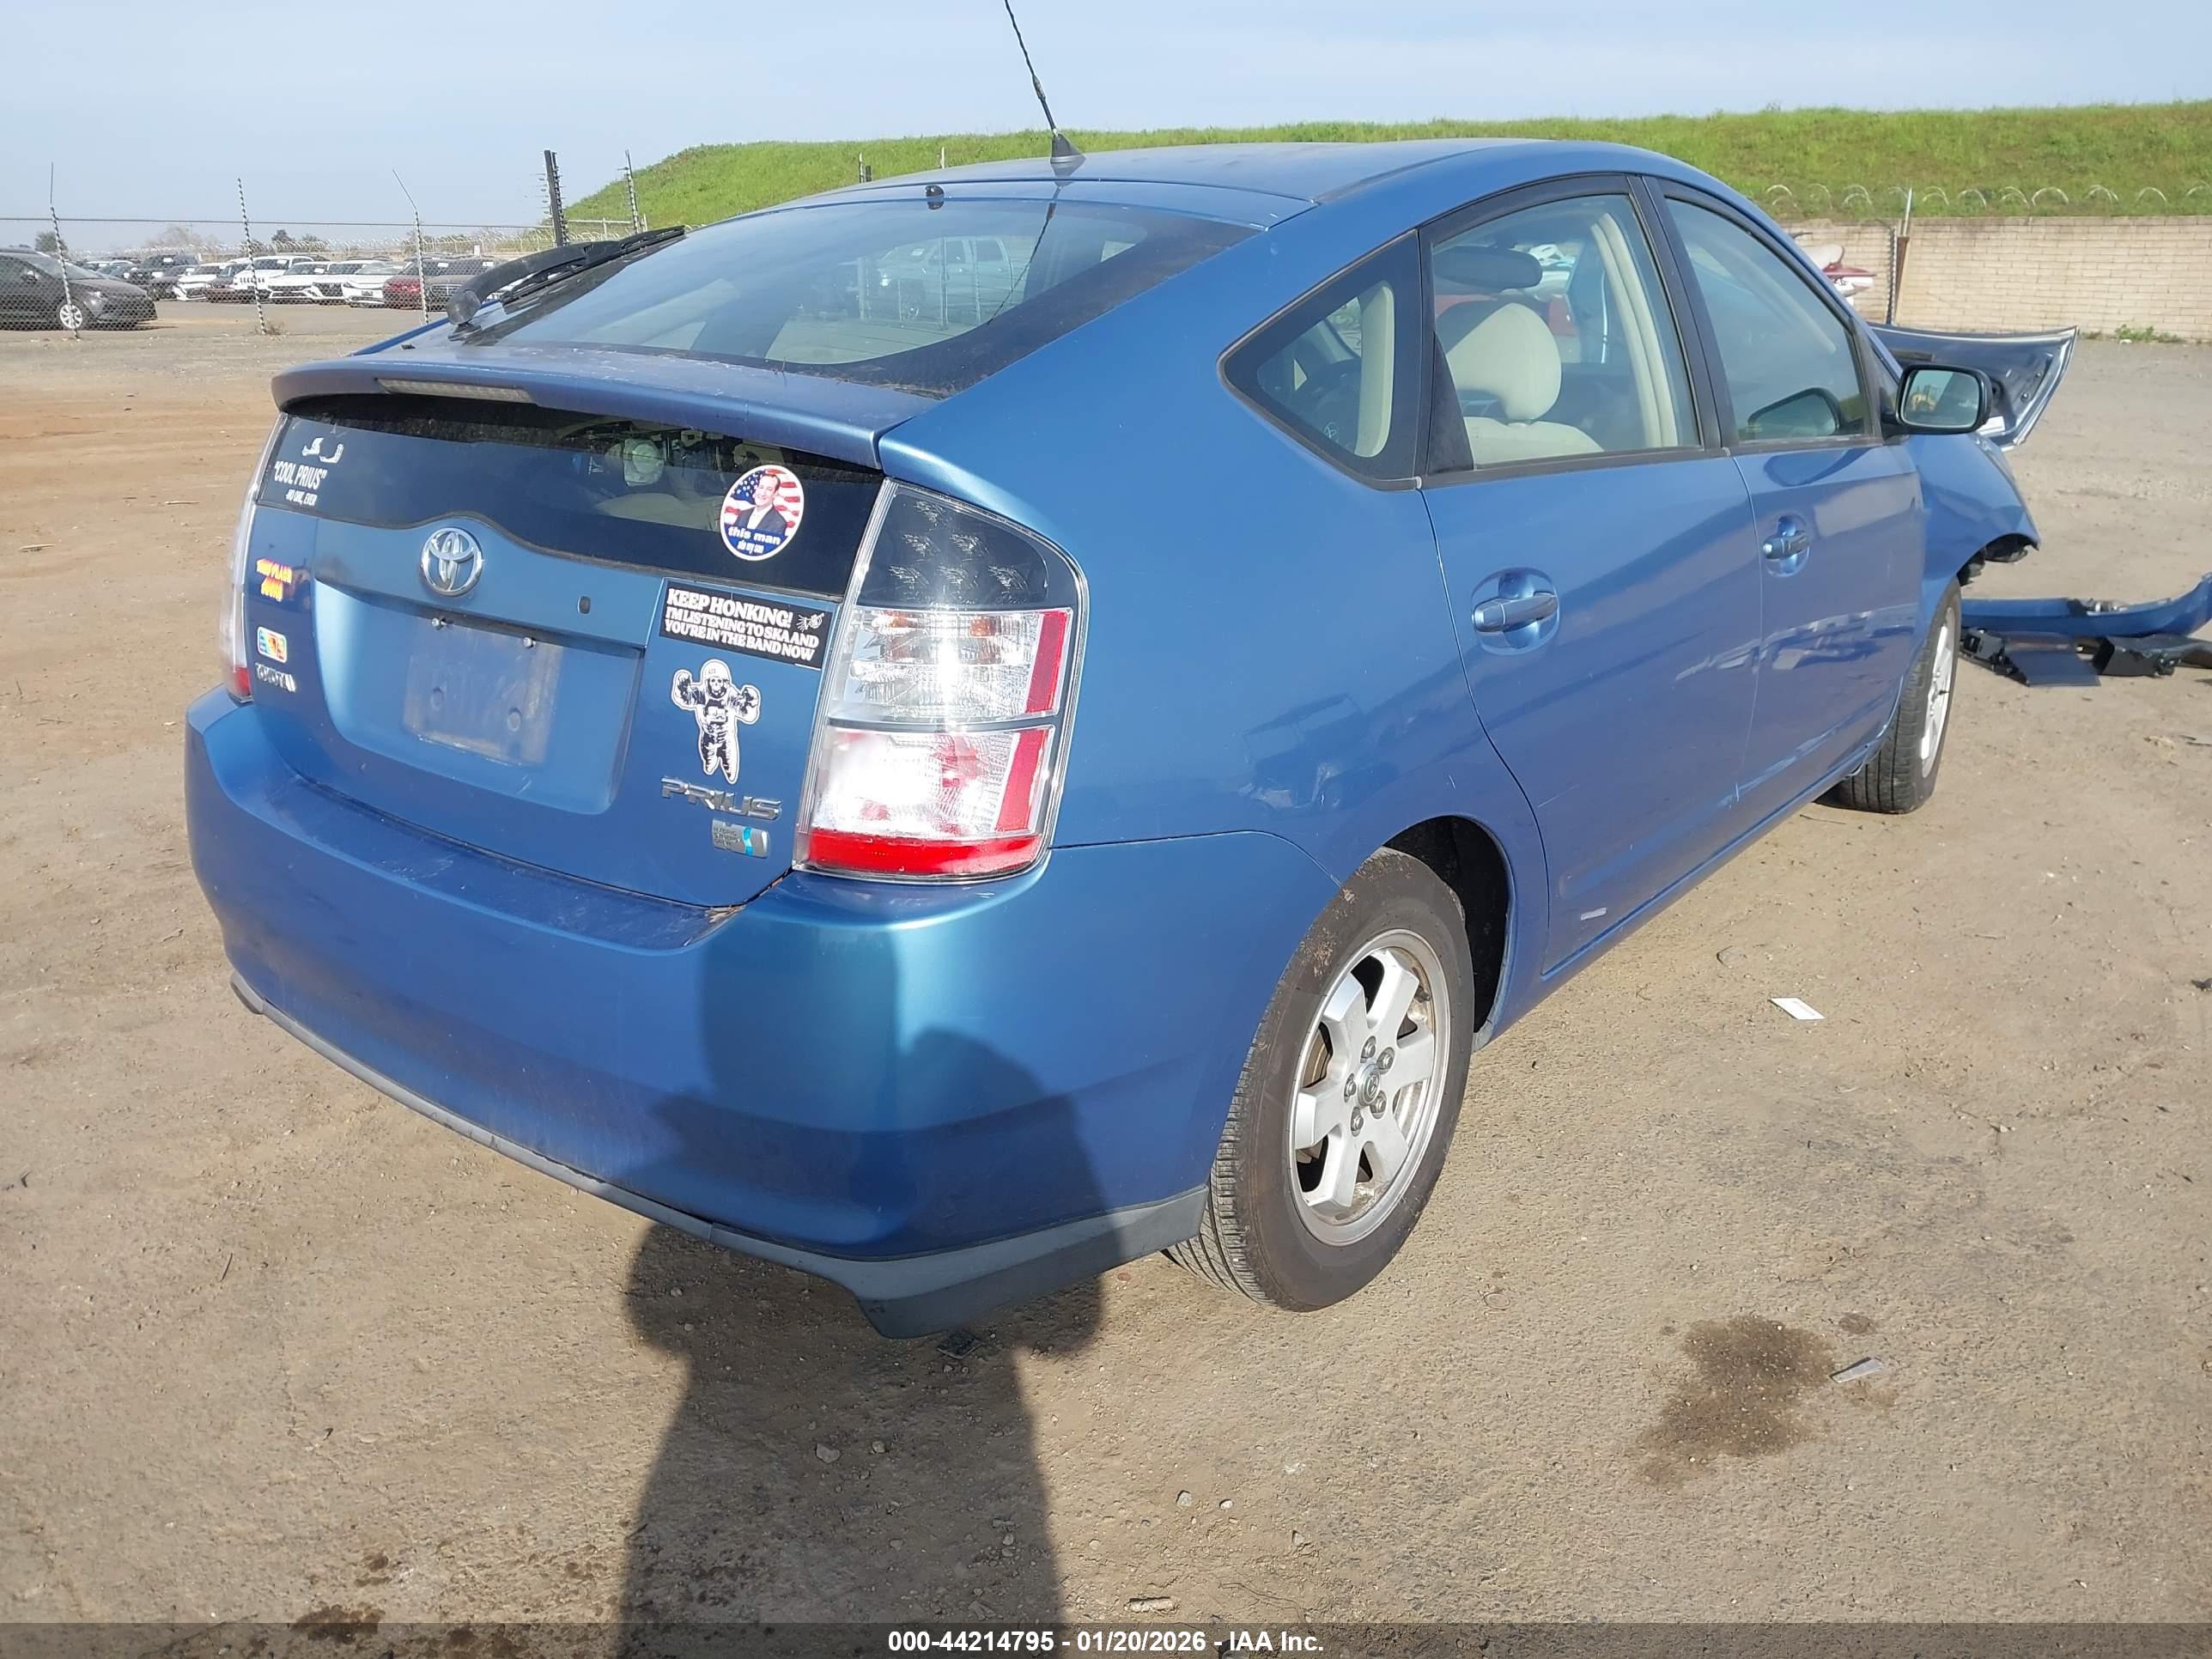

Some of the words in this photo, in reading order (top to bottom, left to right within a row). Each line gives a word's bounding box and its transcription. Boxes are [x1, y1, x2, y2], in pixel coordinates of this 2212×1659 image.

[727, 526, 751, 539] this
[753, 532, 781, 545] man
[665, 606, 683, 621] I'M
[682, 609, 746, 630] LISTENING
[746, 622, 764, 637] TO
[763, 625, 789, 642] SKA
[788, 632, 819, 648] AND
[666, 588, 710, 612] KEEP
[709, 597, 793, 628] HONKING!
[665, 619, 706, 640] YOU'RE
[705, 629, 720, 642] IN
[720, 630, 746, 647] THE
[745, 636, 782, 656] BAND
[781, 644, 816, 661] NOW
[660, 775, 782, 821] PRIUS
